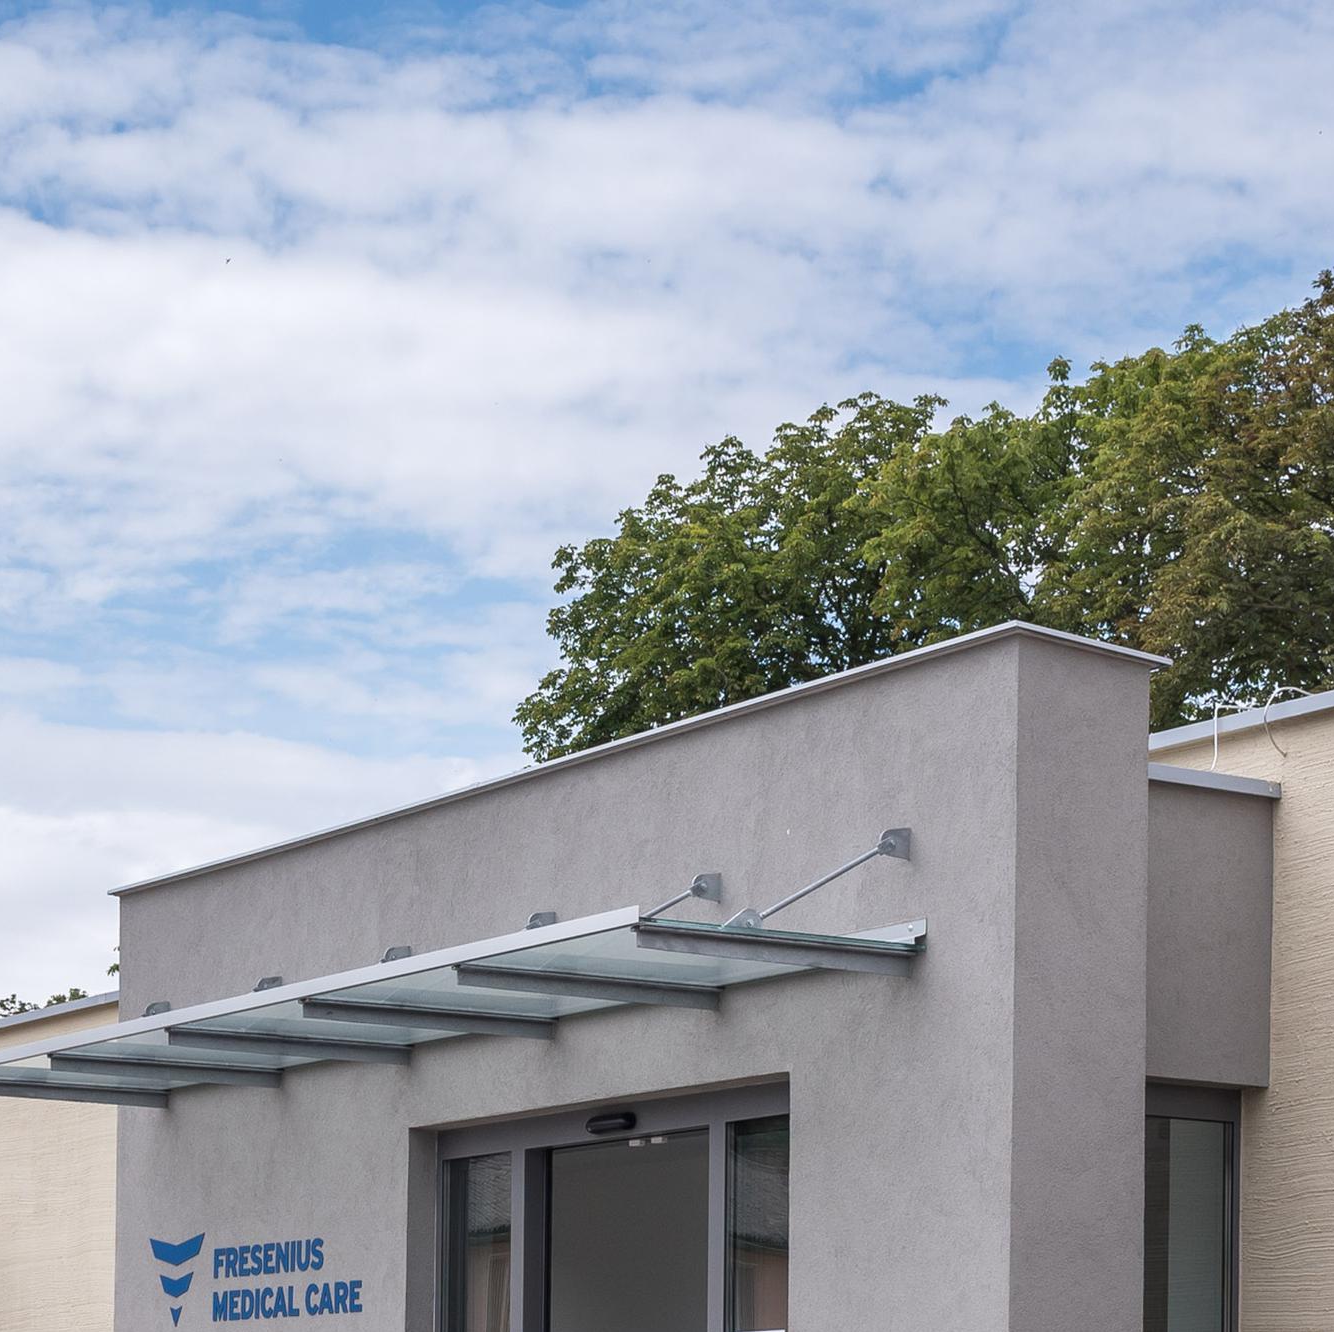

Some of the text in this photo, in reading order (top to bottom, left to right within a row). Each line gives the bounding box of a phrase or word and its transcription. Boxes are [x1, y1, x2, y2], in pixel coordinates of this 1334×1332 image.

[213, 1238, 324, 1279] FRESENIUS
[212, 1280, 363, 1322] MEDICAL CARE
